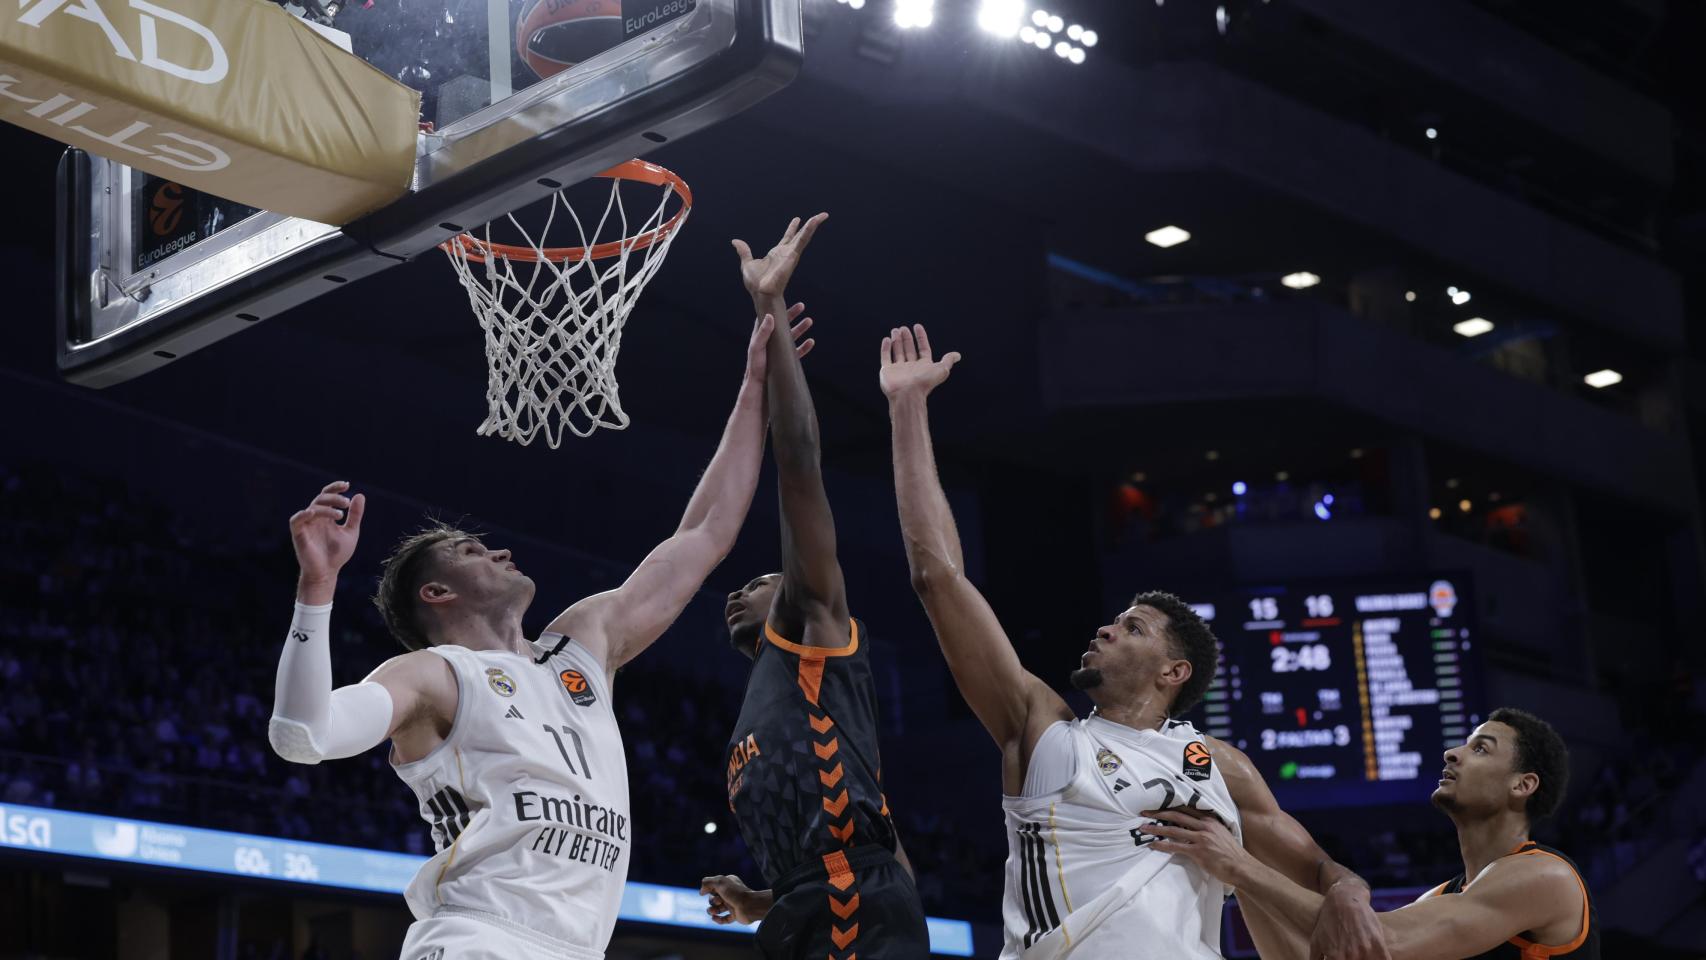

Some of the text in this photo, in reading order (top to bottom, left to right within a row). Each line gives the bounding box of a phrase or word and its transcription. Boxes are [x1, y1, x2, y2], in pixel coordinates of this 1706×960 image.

[17, 0, 229, 84] AD
[138, 231, 196, 268] EuroLeague
[1249, 598, 1278, 620] 15
[1305, 595, 1334, 617] 16
[1271, 645, 1331, 672] 2:48
[1261, 729, 1276, 750] 2
[1334, 725, 1351, 746] 3
[512, 791, 627, 843] Emirate
[532, 827, 621, 873] FLY BETTER
